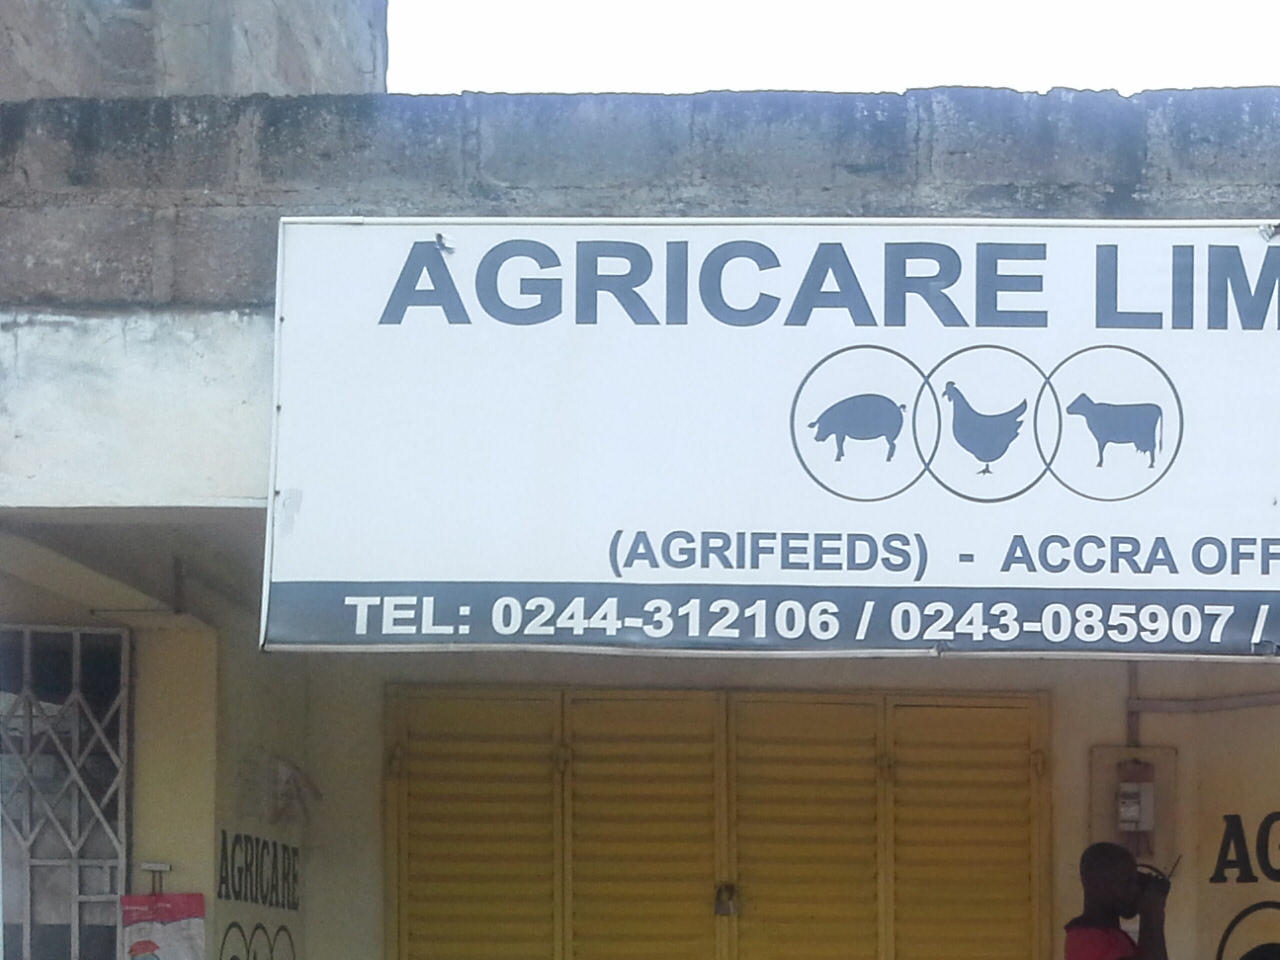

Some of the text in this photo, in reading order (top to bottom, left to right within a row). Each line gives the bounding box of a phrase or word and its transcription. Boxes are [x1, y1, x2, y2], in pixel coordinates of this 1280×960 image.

[377, 239, 1049, 328] AGRICARE
[608, 529, 928, 582] (AGRIFEEDS)
[958, 553, 975, 563] -
[1000, 534, 1179, 575] ACCRA
[344, 596, 470, 636] TEL:
[491, 596, 840, 640] 0244-312106
[855, 600, 876, 641] /
[890, 601, 1235, 644] 0243-085907
[217, 829, 300, 911] AGRICARE
